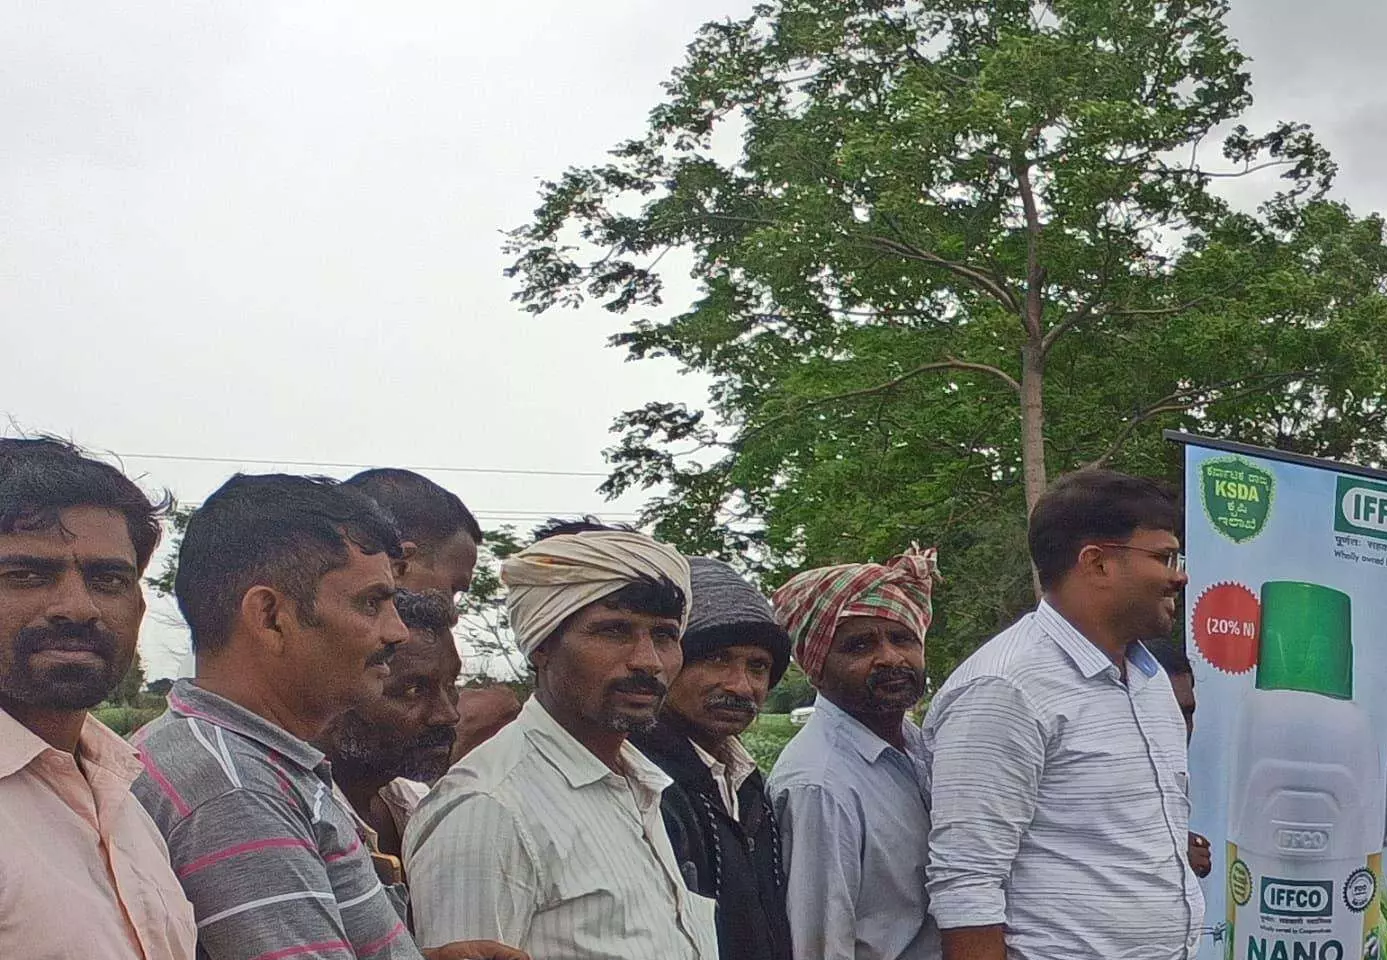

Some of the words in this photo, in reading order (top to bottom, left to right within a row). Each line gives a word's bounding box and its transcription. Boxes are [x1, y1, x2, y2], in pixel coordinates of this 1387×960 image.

[1215, 480, 1259, 502] KSDA
[1334, 550, 1359, 563] Wholly
[1362, 556, 1384, 566] owned
[1207, 617, 1240, 635] (20%
[1243, 622, 1255, 640] N)
[1271, 888, 1321, 907] IFFCO
